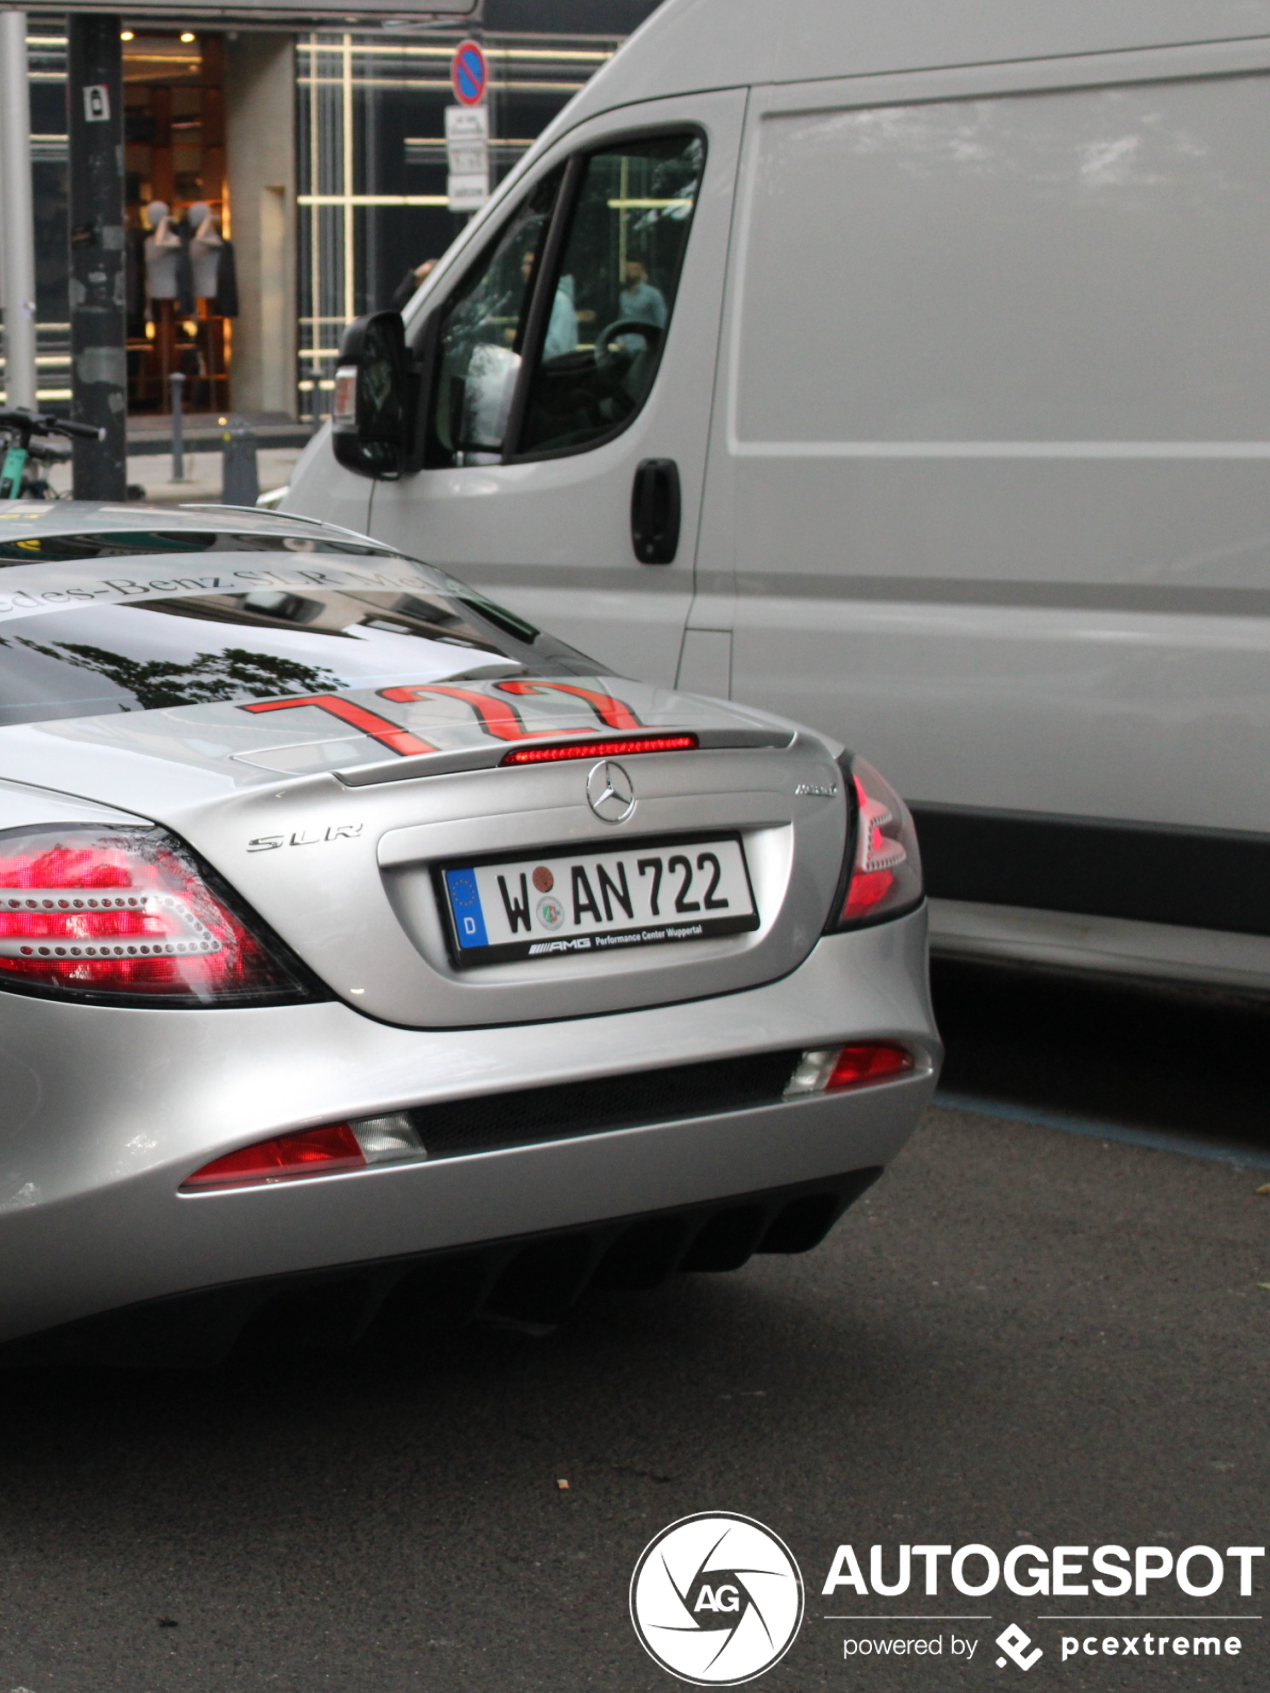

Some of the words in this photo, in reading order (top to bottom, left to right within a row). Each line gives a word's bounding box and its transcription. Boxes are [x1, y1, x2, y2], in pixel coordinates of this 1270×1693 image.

[233, 569, 346, 587] SLR
[234, 680, 676, 757] 722
[246, 822, 364, 853] SLR
[496, 871, 532, 934] W
[571, 860, 635, 926] AN
[637, 851, 730, 916] 722
[464, 916, 477, 934] D
[547, 937, 592, 953] AMG
[594, 932, 642, 947] Performance
[642, 929, 666, 941] Center
[666, 924, 703, 937] Wuppertal
